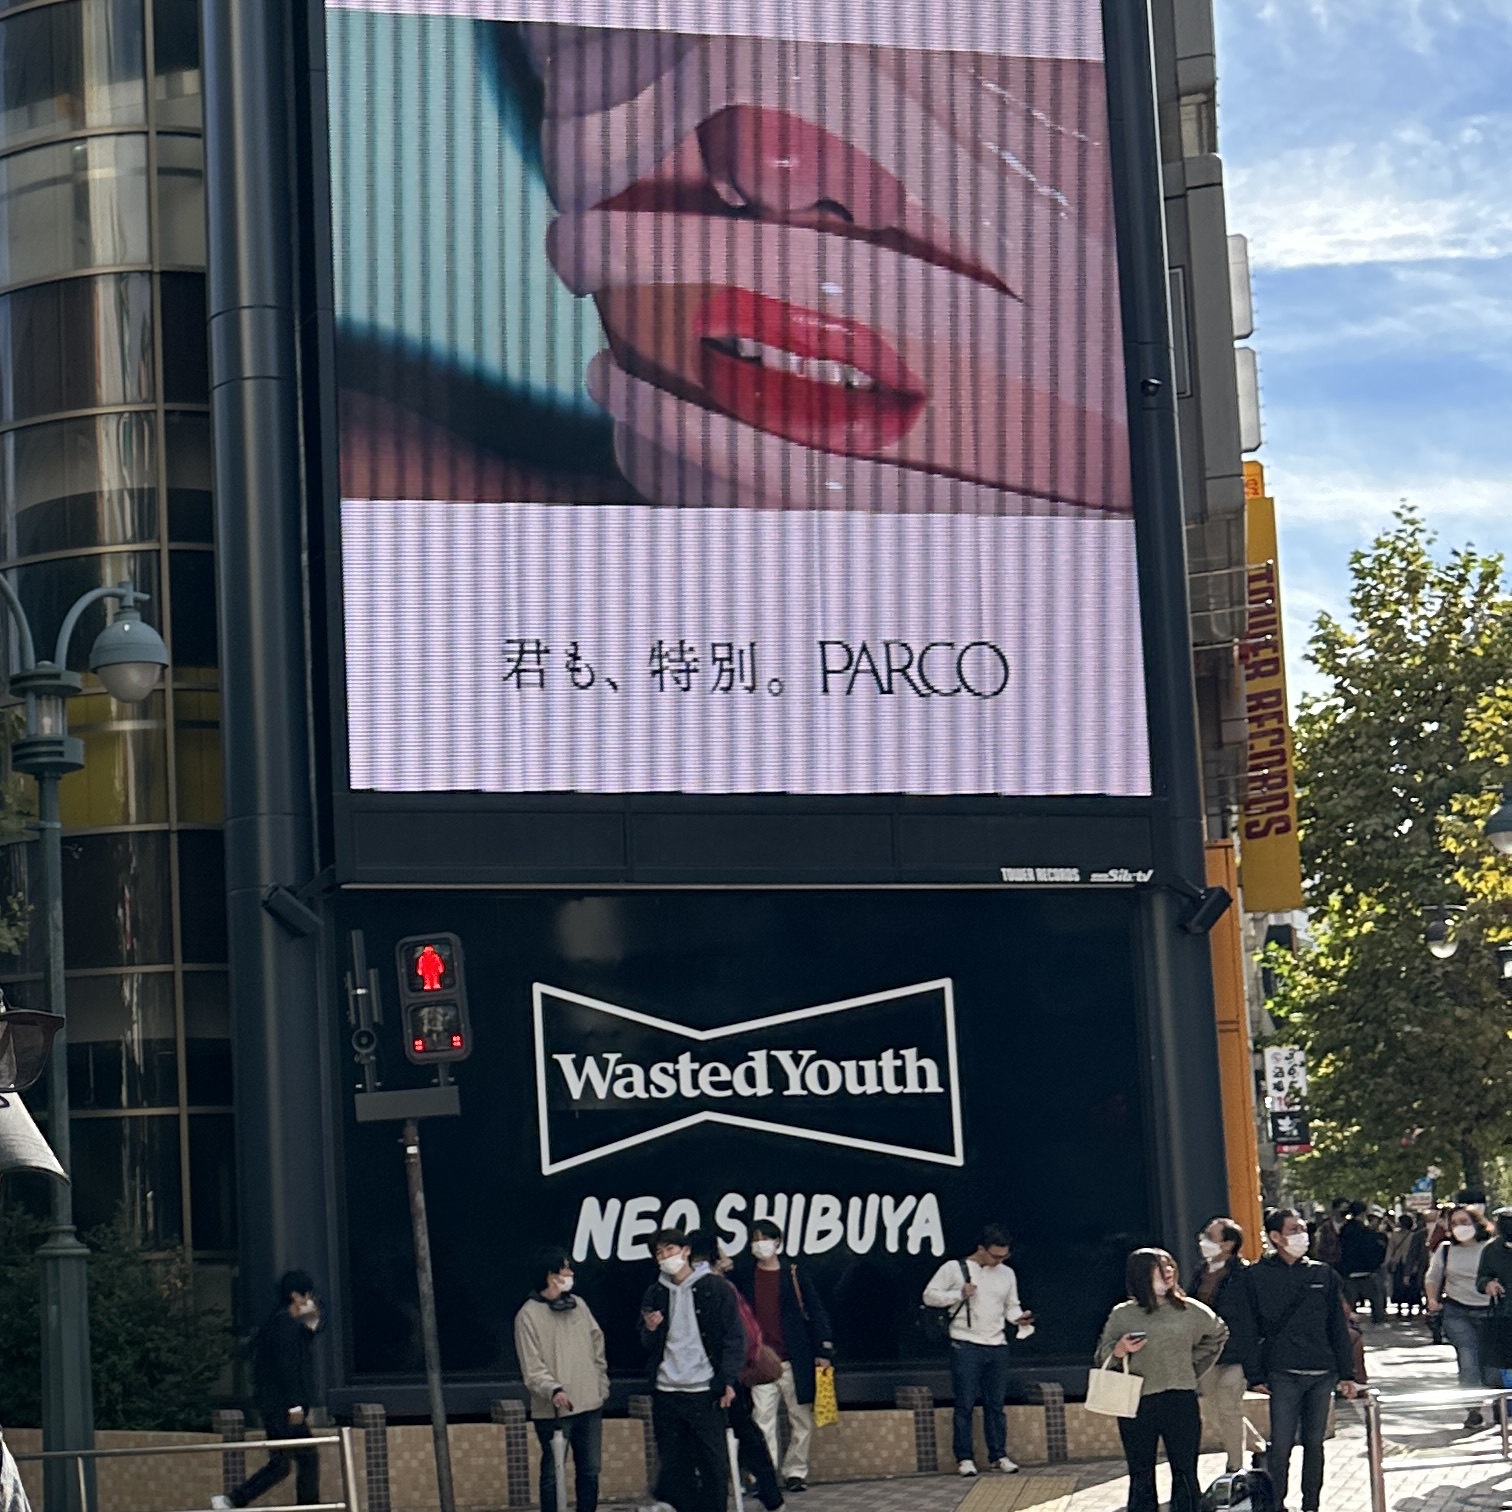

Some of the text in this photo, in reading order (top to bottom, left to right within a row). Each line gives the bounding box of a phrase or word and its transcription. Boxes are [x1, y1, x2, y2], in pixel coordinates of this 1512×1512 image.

[817, 639, 1010, 699] PARCO
[572, 1192, 946, 1262] NEO SHIBUYA
